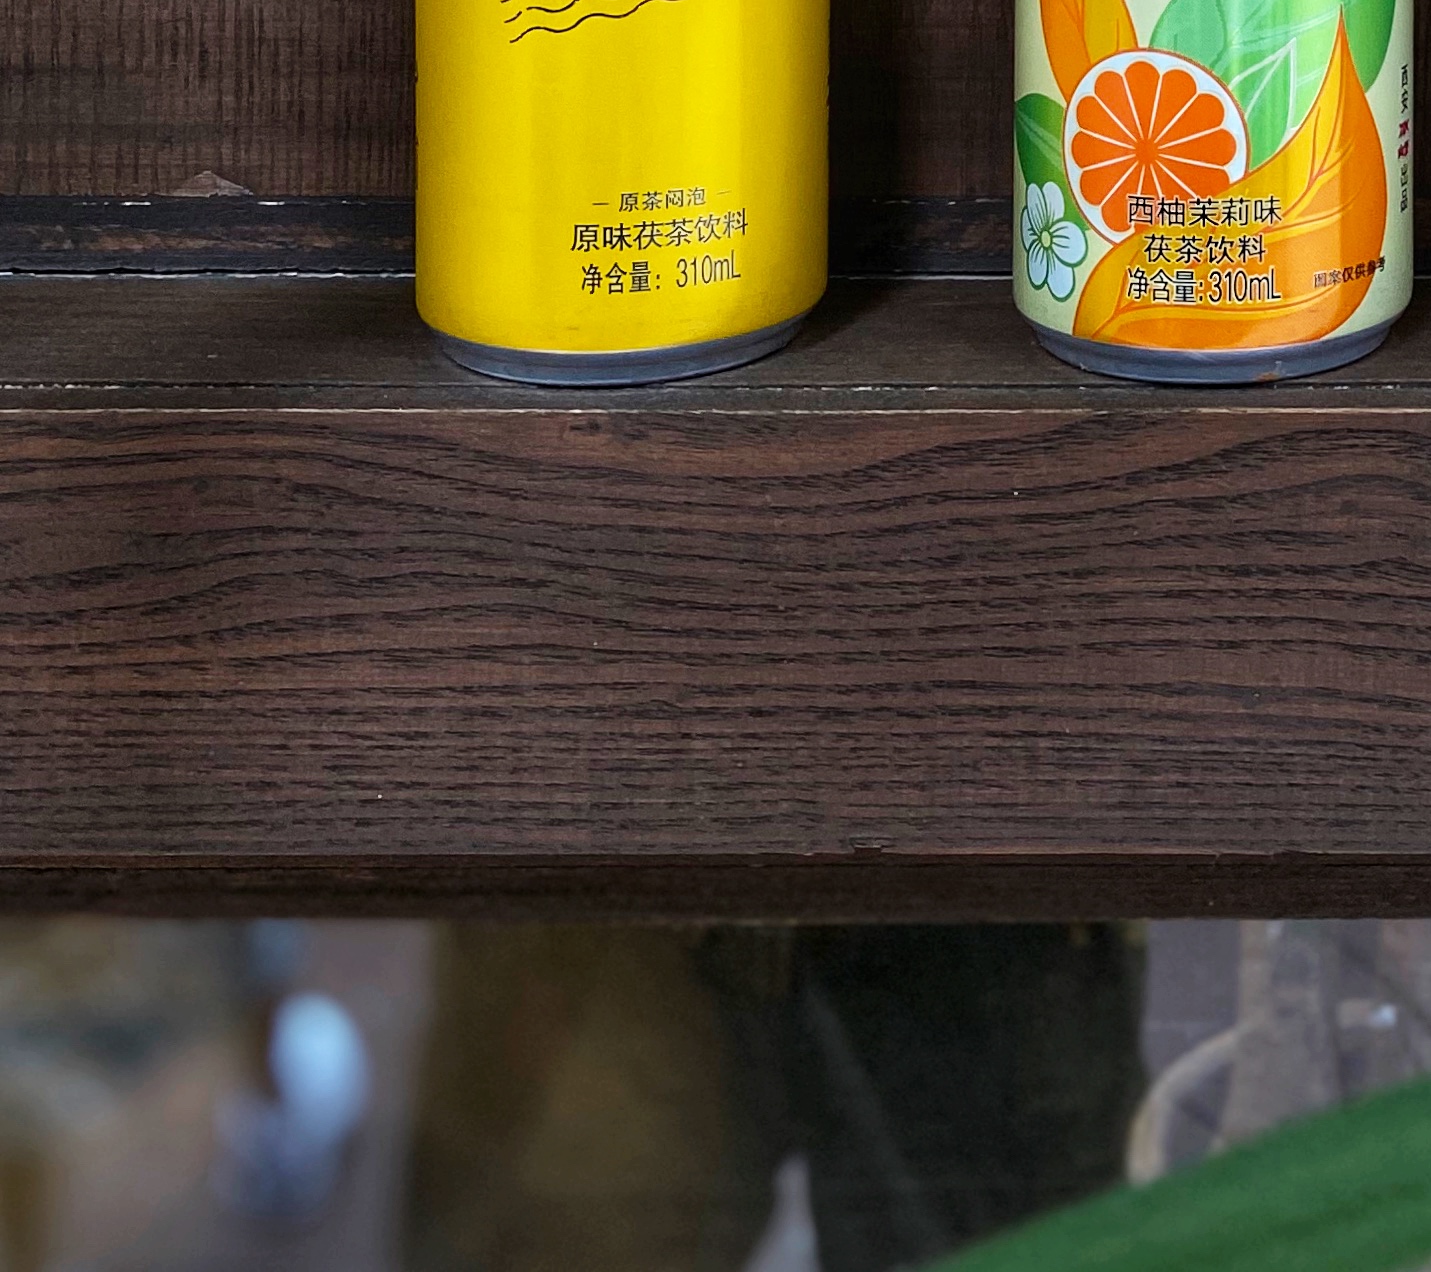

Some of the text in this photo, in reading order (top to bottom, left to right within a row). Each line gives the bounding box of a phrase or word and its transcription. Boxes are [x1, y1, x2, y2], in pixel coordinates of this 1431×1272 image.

[618, 187, 707, 213] 原茶闷泡
[1127, 195, 1283, 227] 西柚茉莉味
[570, 208, 748, 253] 原味茯茶饮料
[1143, 234, 1266, 264] 茯茶饮料
